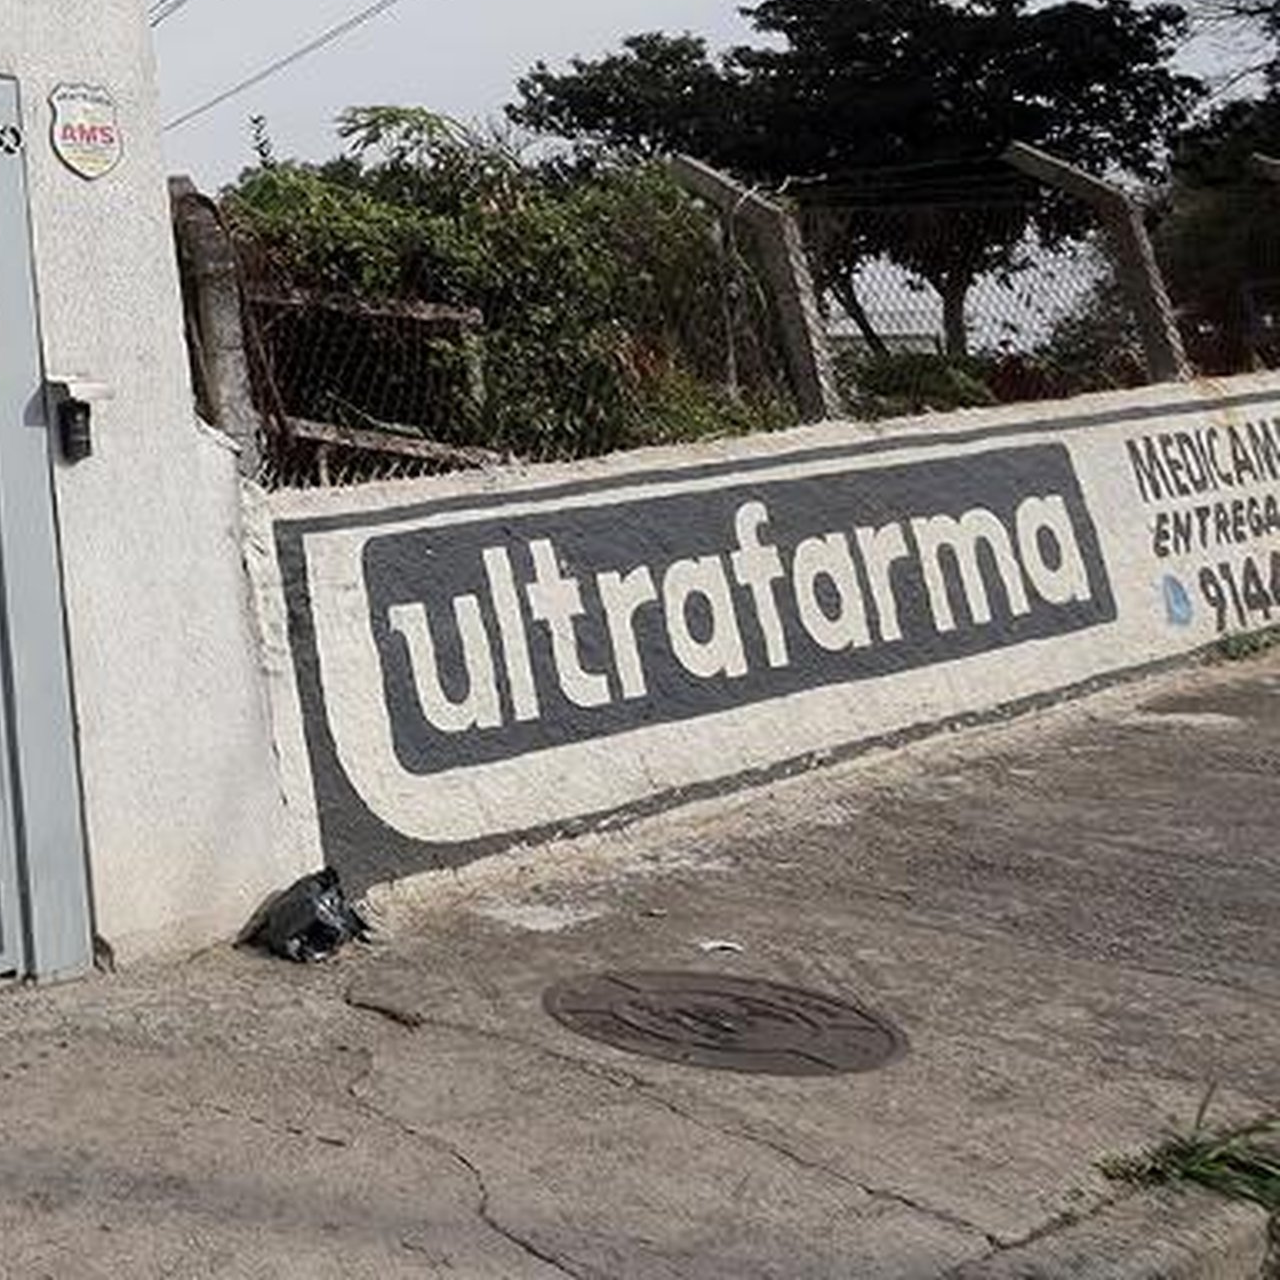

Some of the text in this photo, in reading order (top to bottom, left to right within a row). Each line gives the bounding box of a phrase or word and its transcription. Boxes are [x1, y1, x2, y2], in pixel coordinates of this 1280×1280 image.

[61, 122, 115, 145] AMS
[1125, 418, 1280, 503] MEDICAM
[388, 494, 1091, 733] ultrafarma
